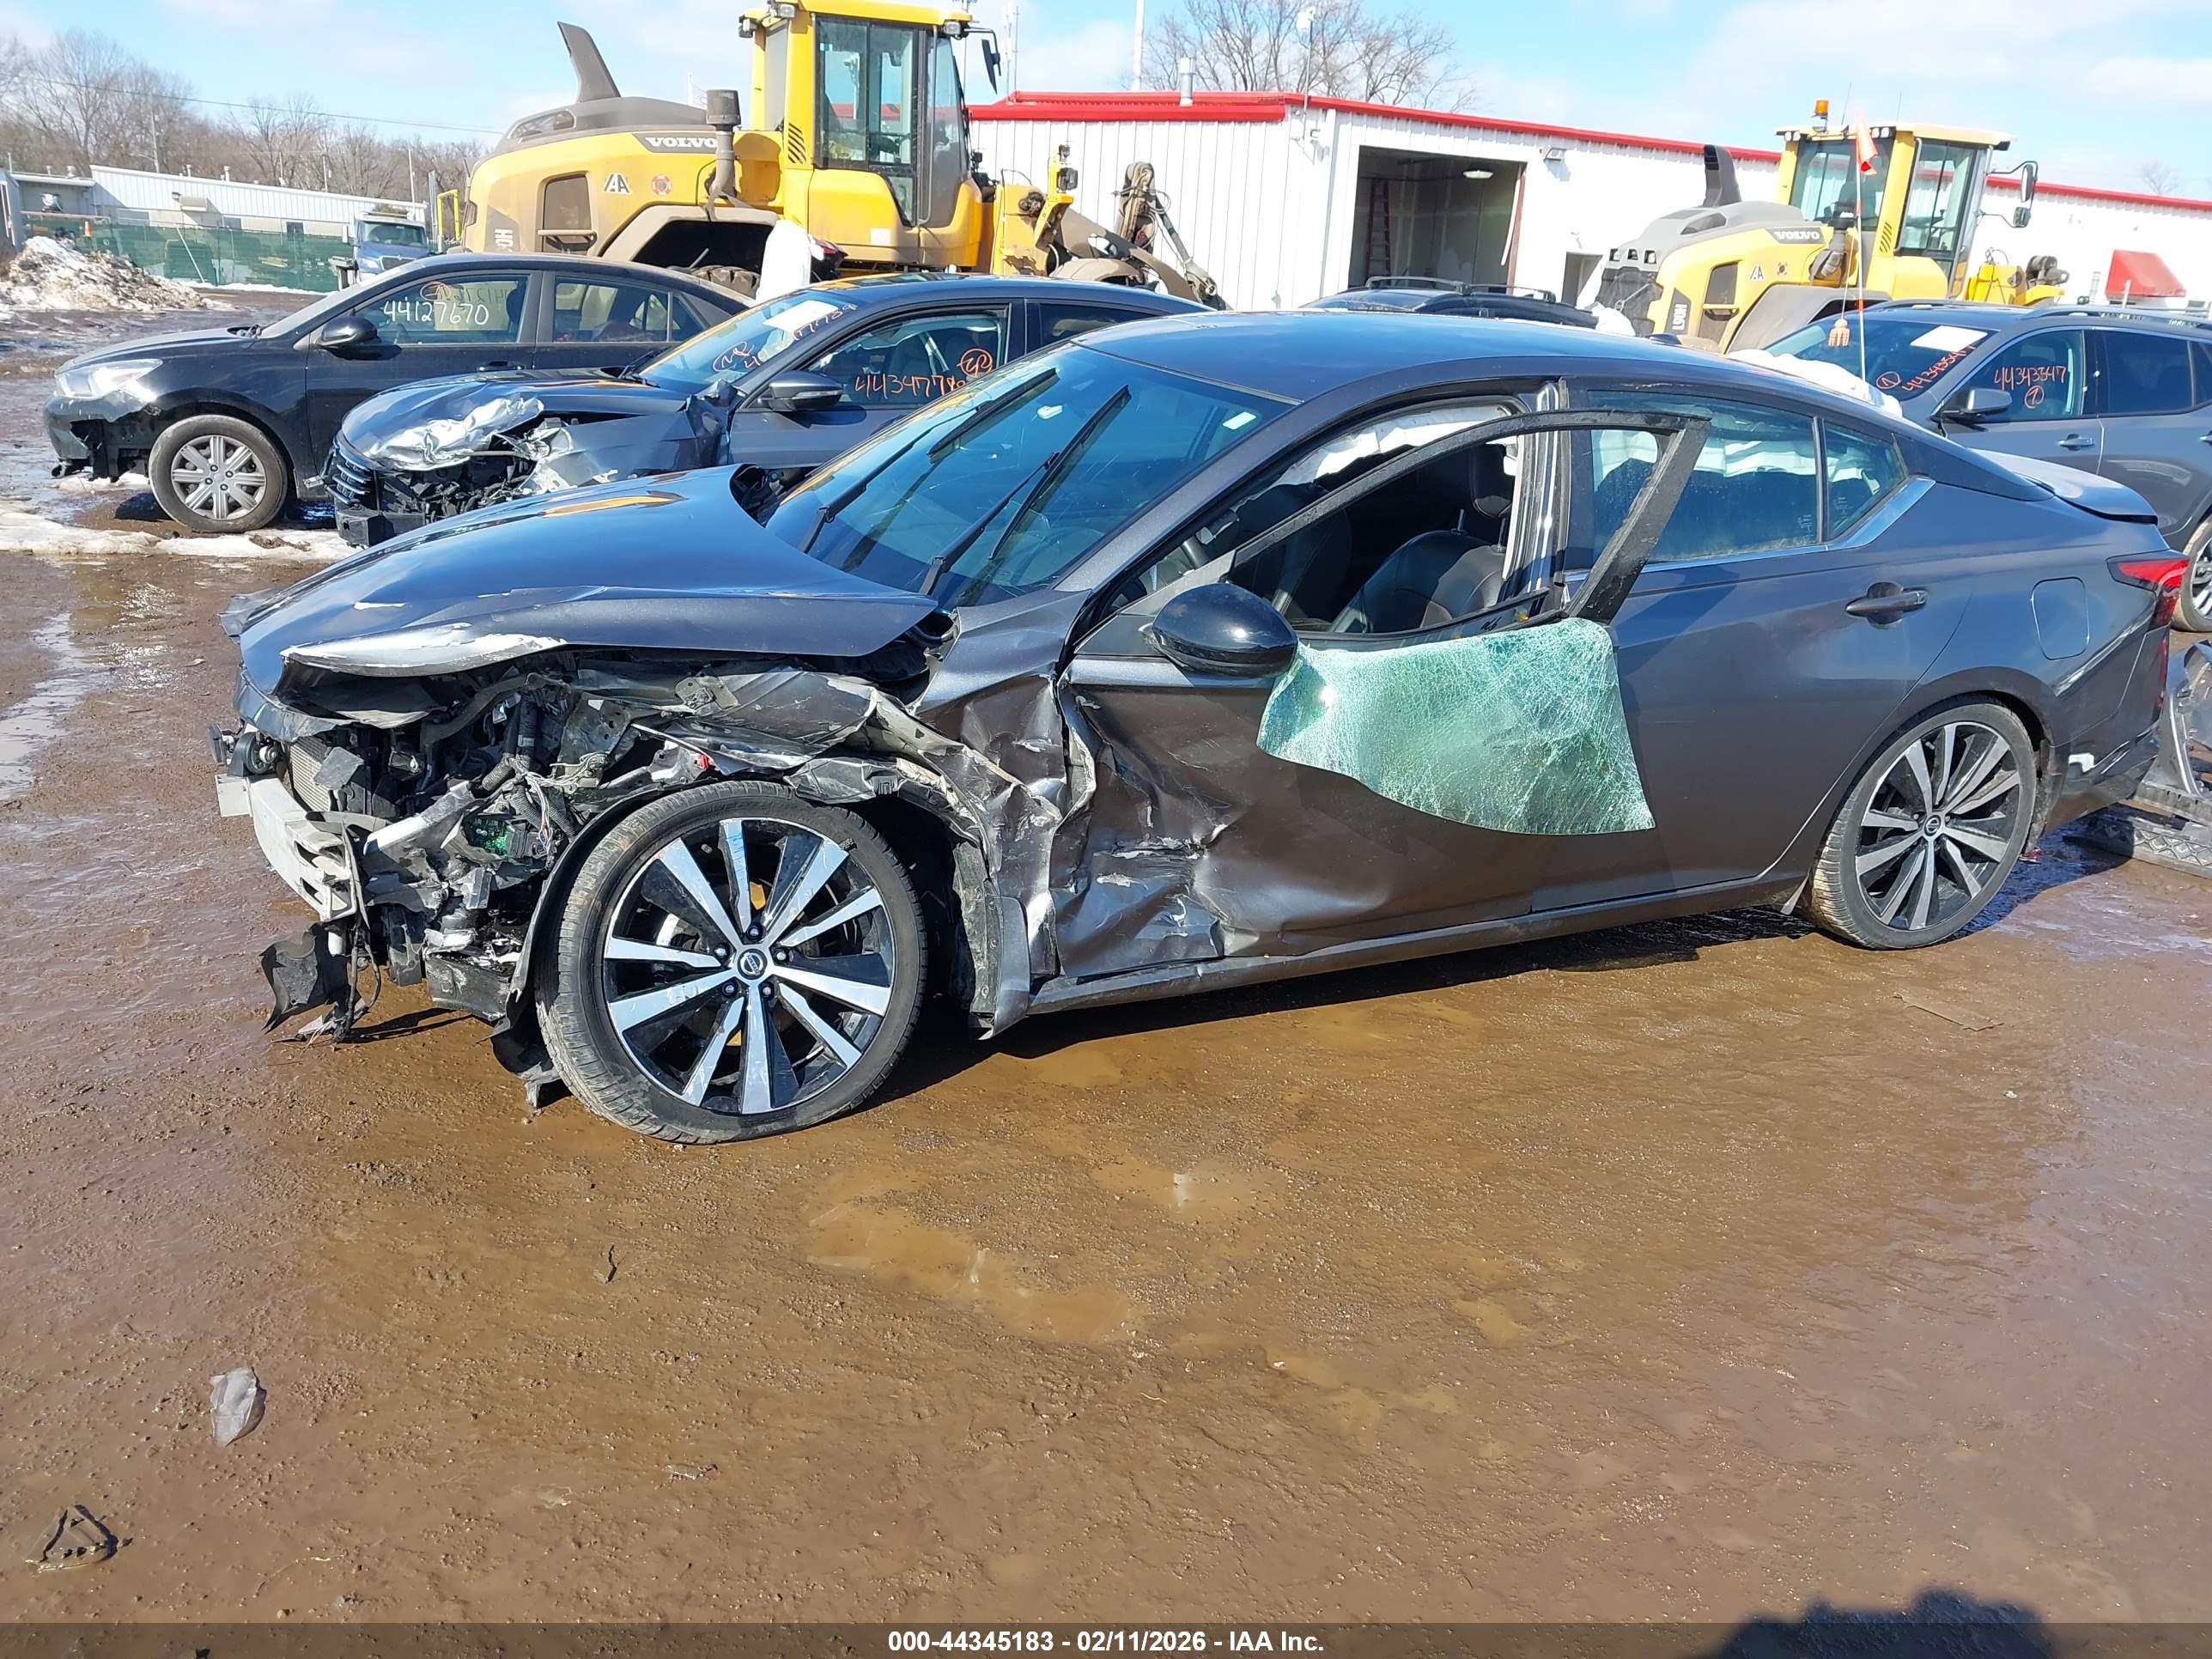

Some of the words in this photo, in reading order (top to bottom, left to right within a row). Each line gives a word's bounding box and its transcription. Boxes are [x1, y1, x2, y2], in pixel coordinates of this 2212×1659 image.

[646, 137, 718, 148] VOLVO
[1773, 230, 1820, 240] VOLVO
[382, 297, 489, 325] 44127670
[1672, 303, 1687, 331] L90H
